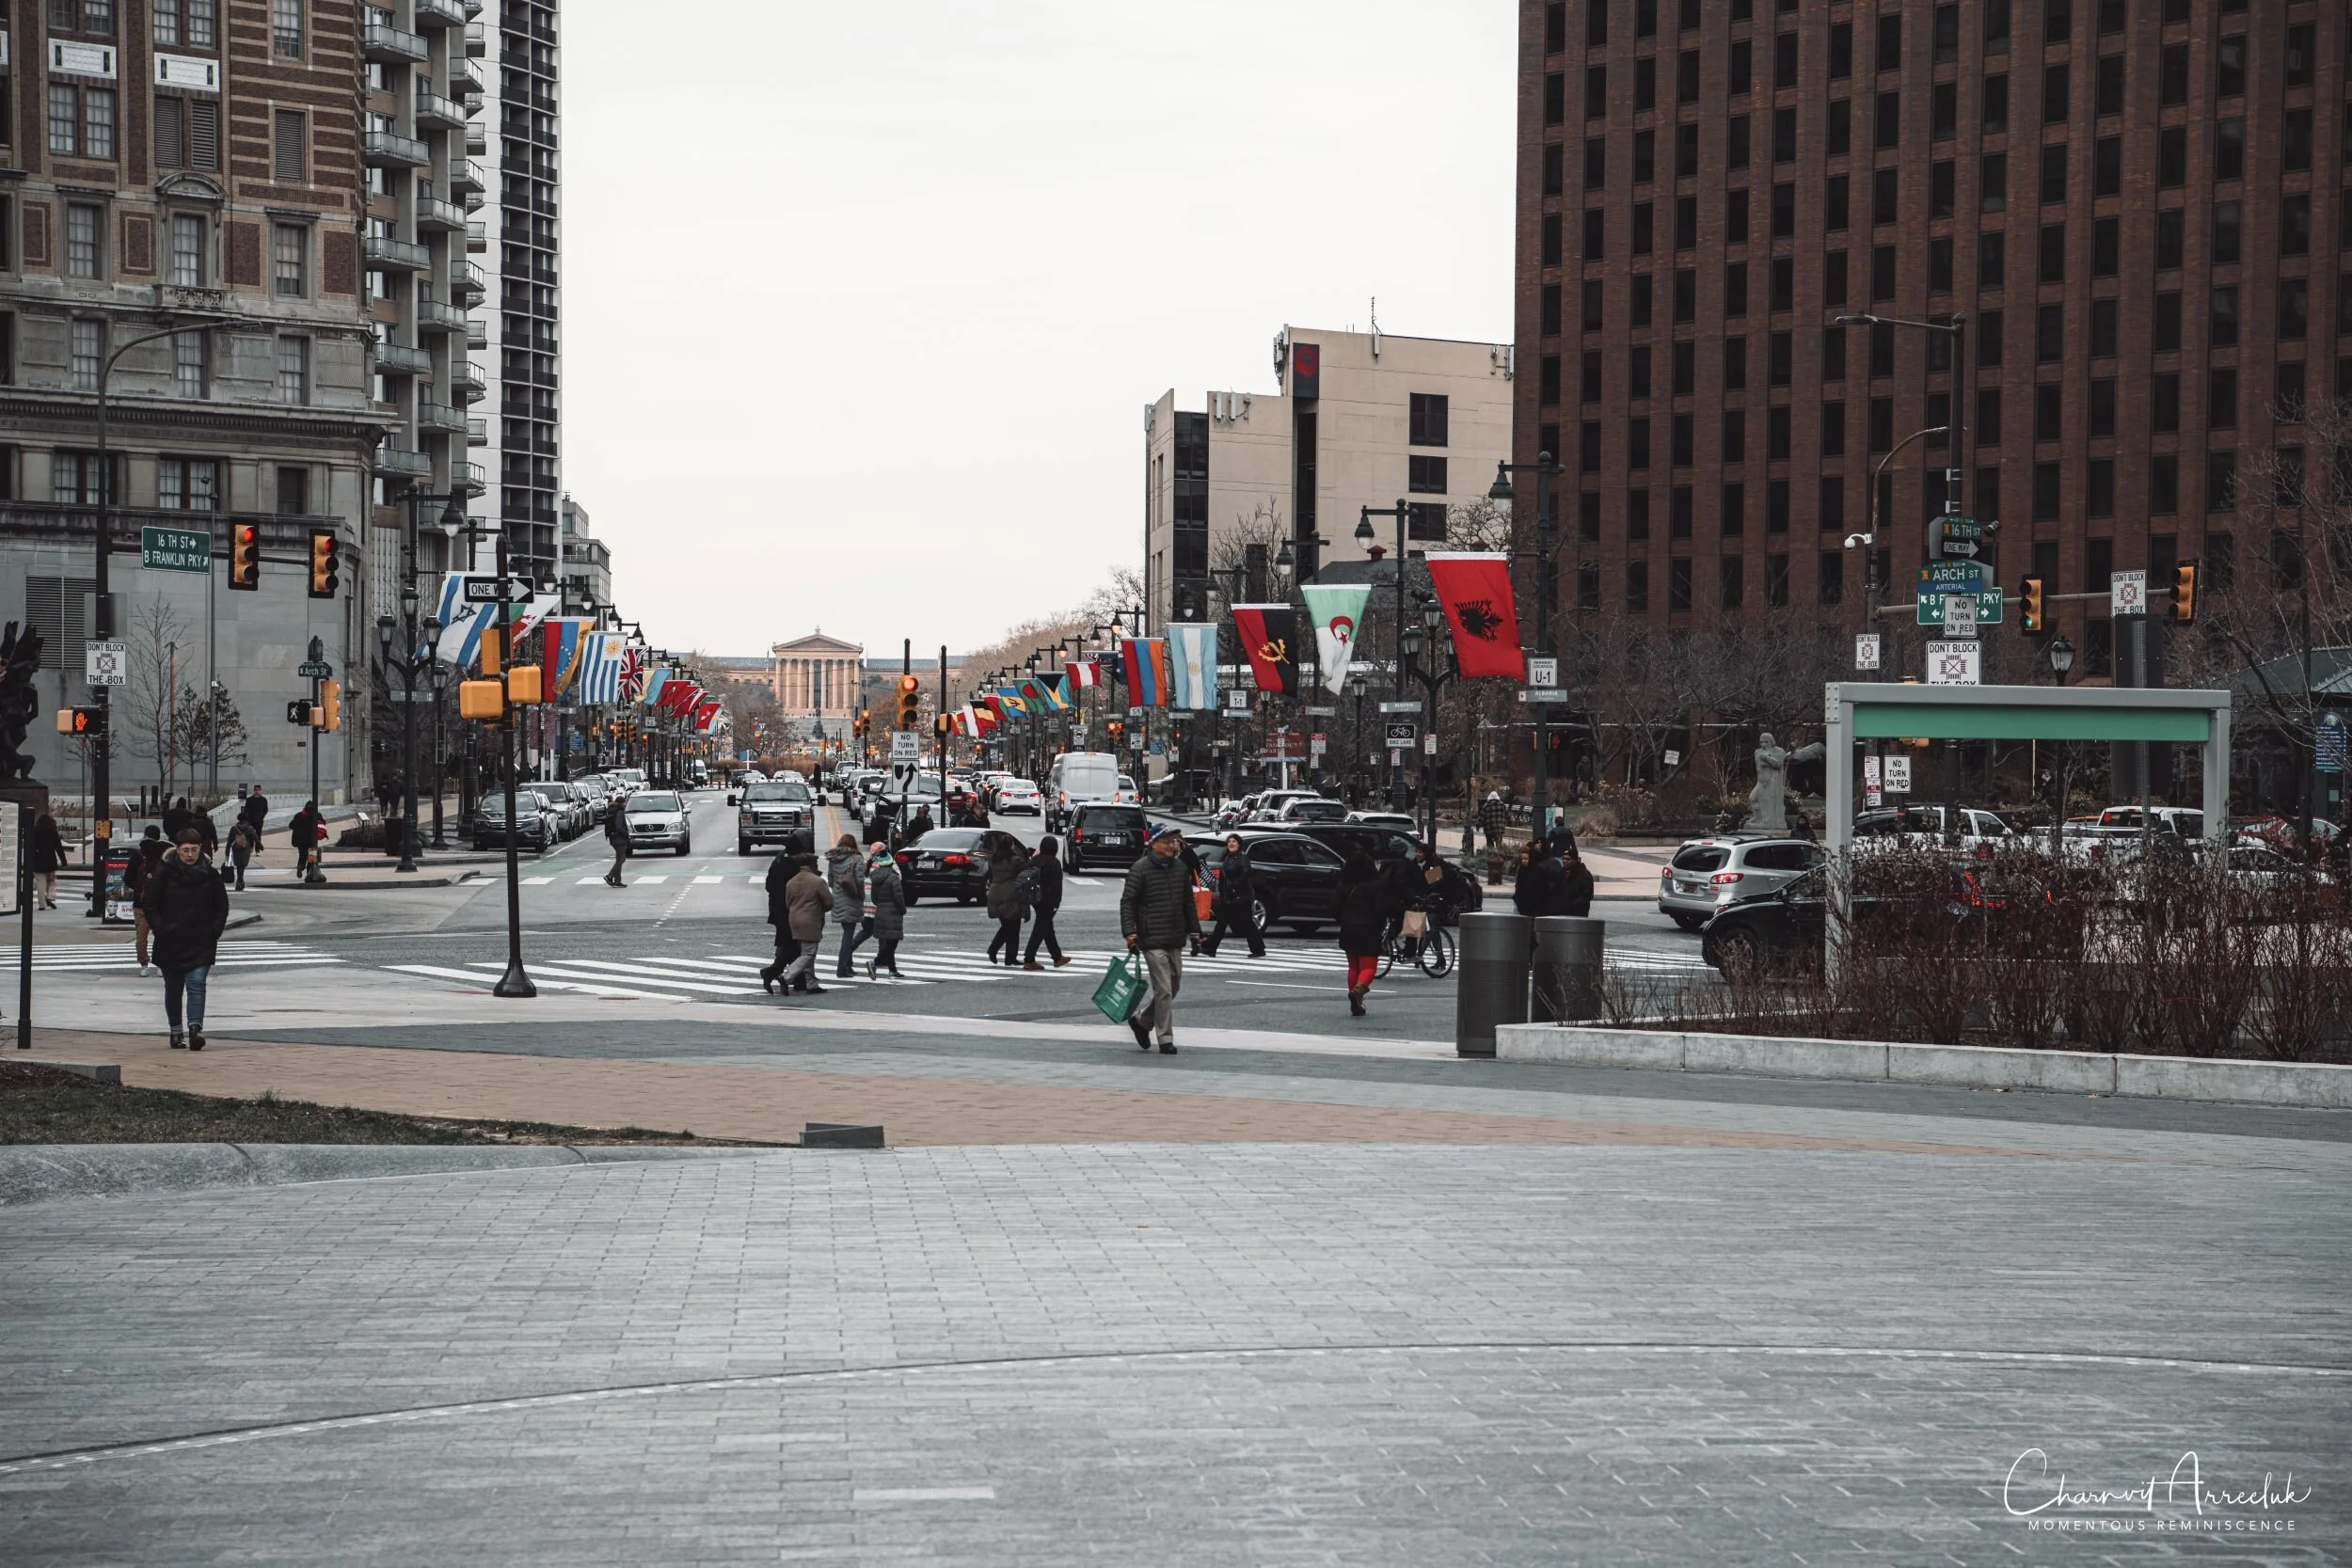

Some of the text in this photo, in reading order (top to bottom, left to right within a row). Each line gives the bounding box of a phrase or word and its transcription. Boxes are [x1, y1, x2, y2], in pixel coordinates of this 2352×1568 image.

[1952, 524, 1981, 537] 16 TH ST
[157, 533, 188, 549] 16 TH ST
[144, 550, 202, 568] B FRANKLIN PKY
[1932, 568, 1979, 581] ARCH ST
[2127, 573, 2145, 581] BLOCK
[471, 584, 513, 595] ONE WY
[1930, 594, 1936, 606] B
[1983, 593, 2000, 604] PKY
[1954, 601, 1967, 610] NO
[2129, 605, 2144, 613] BOX
[1950, 612, 1971, 621] TURN
[1946, 624, 1974, 632] ON RED
[105, 643, 125, 652] BLOCK
[1952, 643, 1978, 653] BLOCK
[304, 667, 319, 675] Arch
[88, 674, 124, 685] THE BOX
[1535, 670, 1550, 684] U-1
[1892, 759, 1902, 768] NO
[1888, 769, 1907, 778] TURN
[1885, 779, 1895, 787] ON
[1896, 779, 1910, 787] RED
